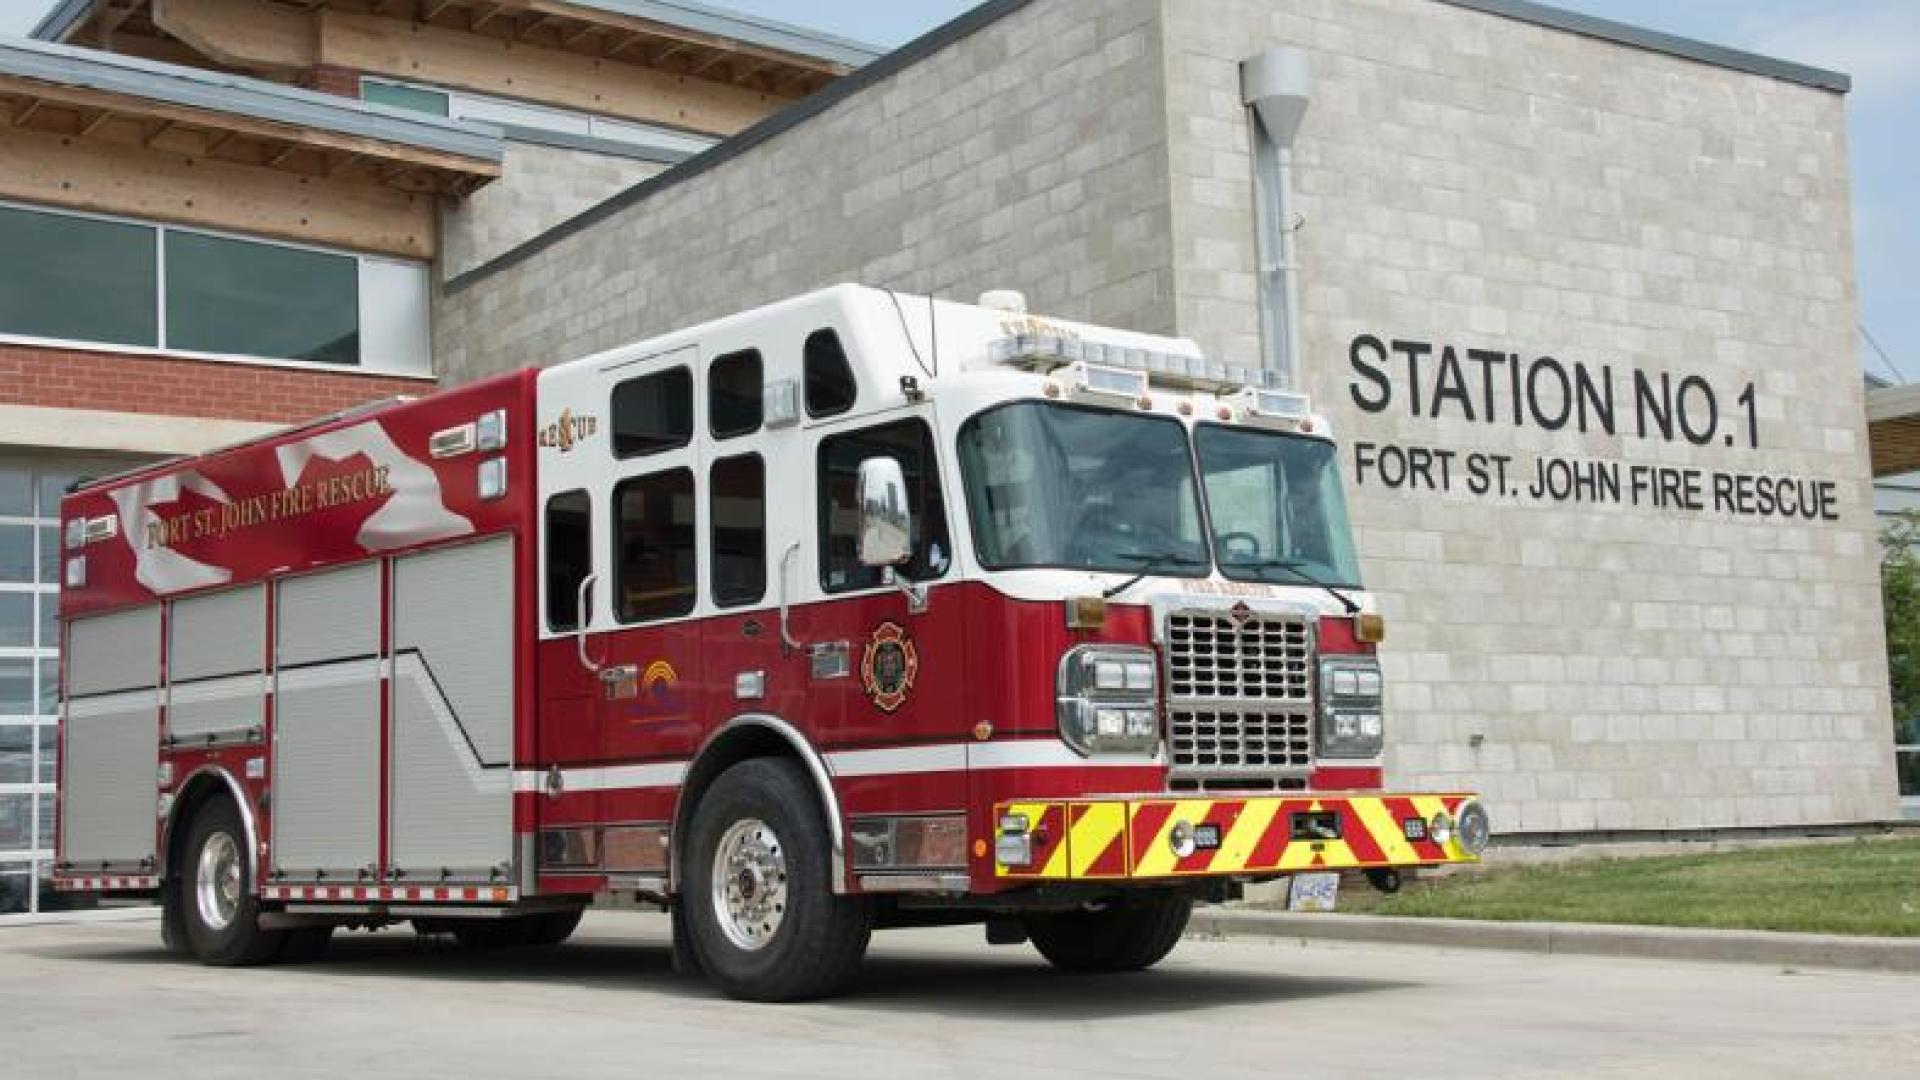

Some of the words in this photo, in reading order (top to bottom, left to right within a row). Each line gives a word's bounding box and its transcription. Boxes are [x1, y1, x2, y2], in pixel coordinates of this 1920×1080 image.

[1350, 334, 1616, 436] STATION
[1634, 369, 1758, 450] NO.1
[146, 512, 190, 549] FORT
[220, 495, 265, 539] JOHN
[270, 485, 313, 520] FIRE
[316, 464, 392, 508] RESCUE
[1355, 443, 1455, 491] FORT
[1466, 453, 1519, 497] ST.
[1529, 458, 1621, 503] JOHN
[1631, 465, 1704, 511] FIRE
[1712, 472, 1840, 521] RESCUE
